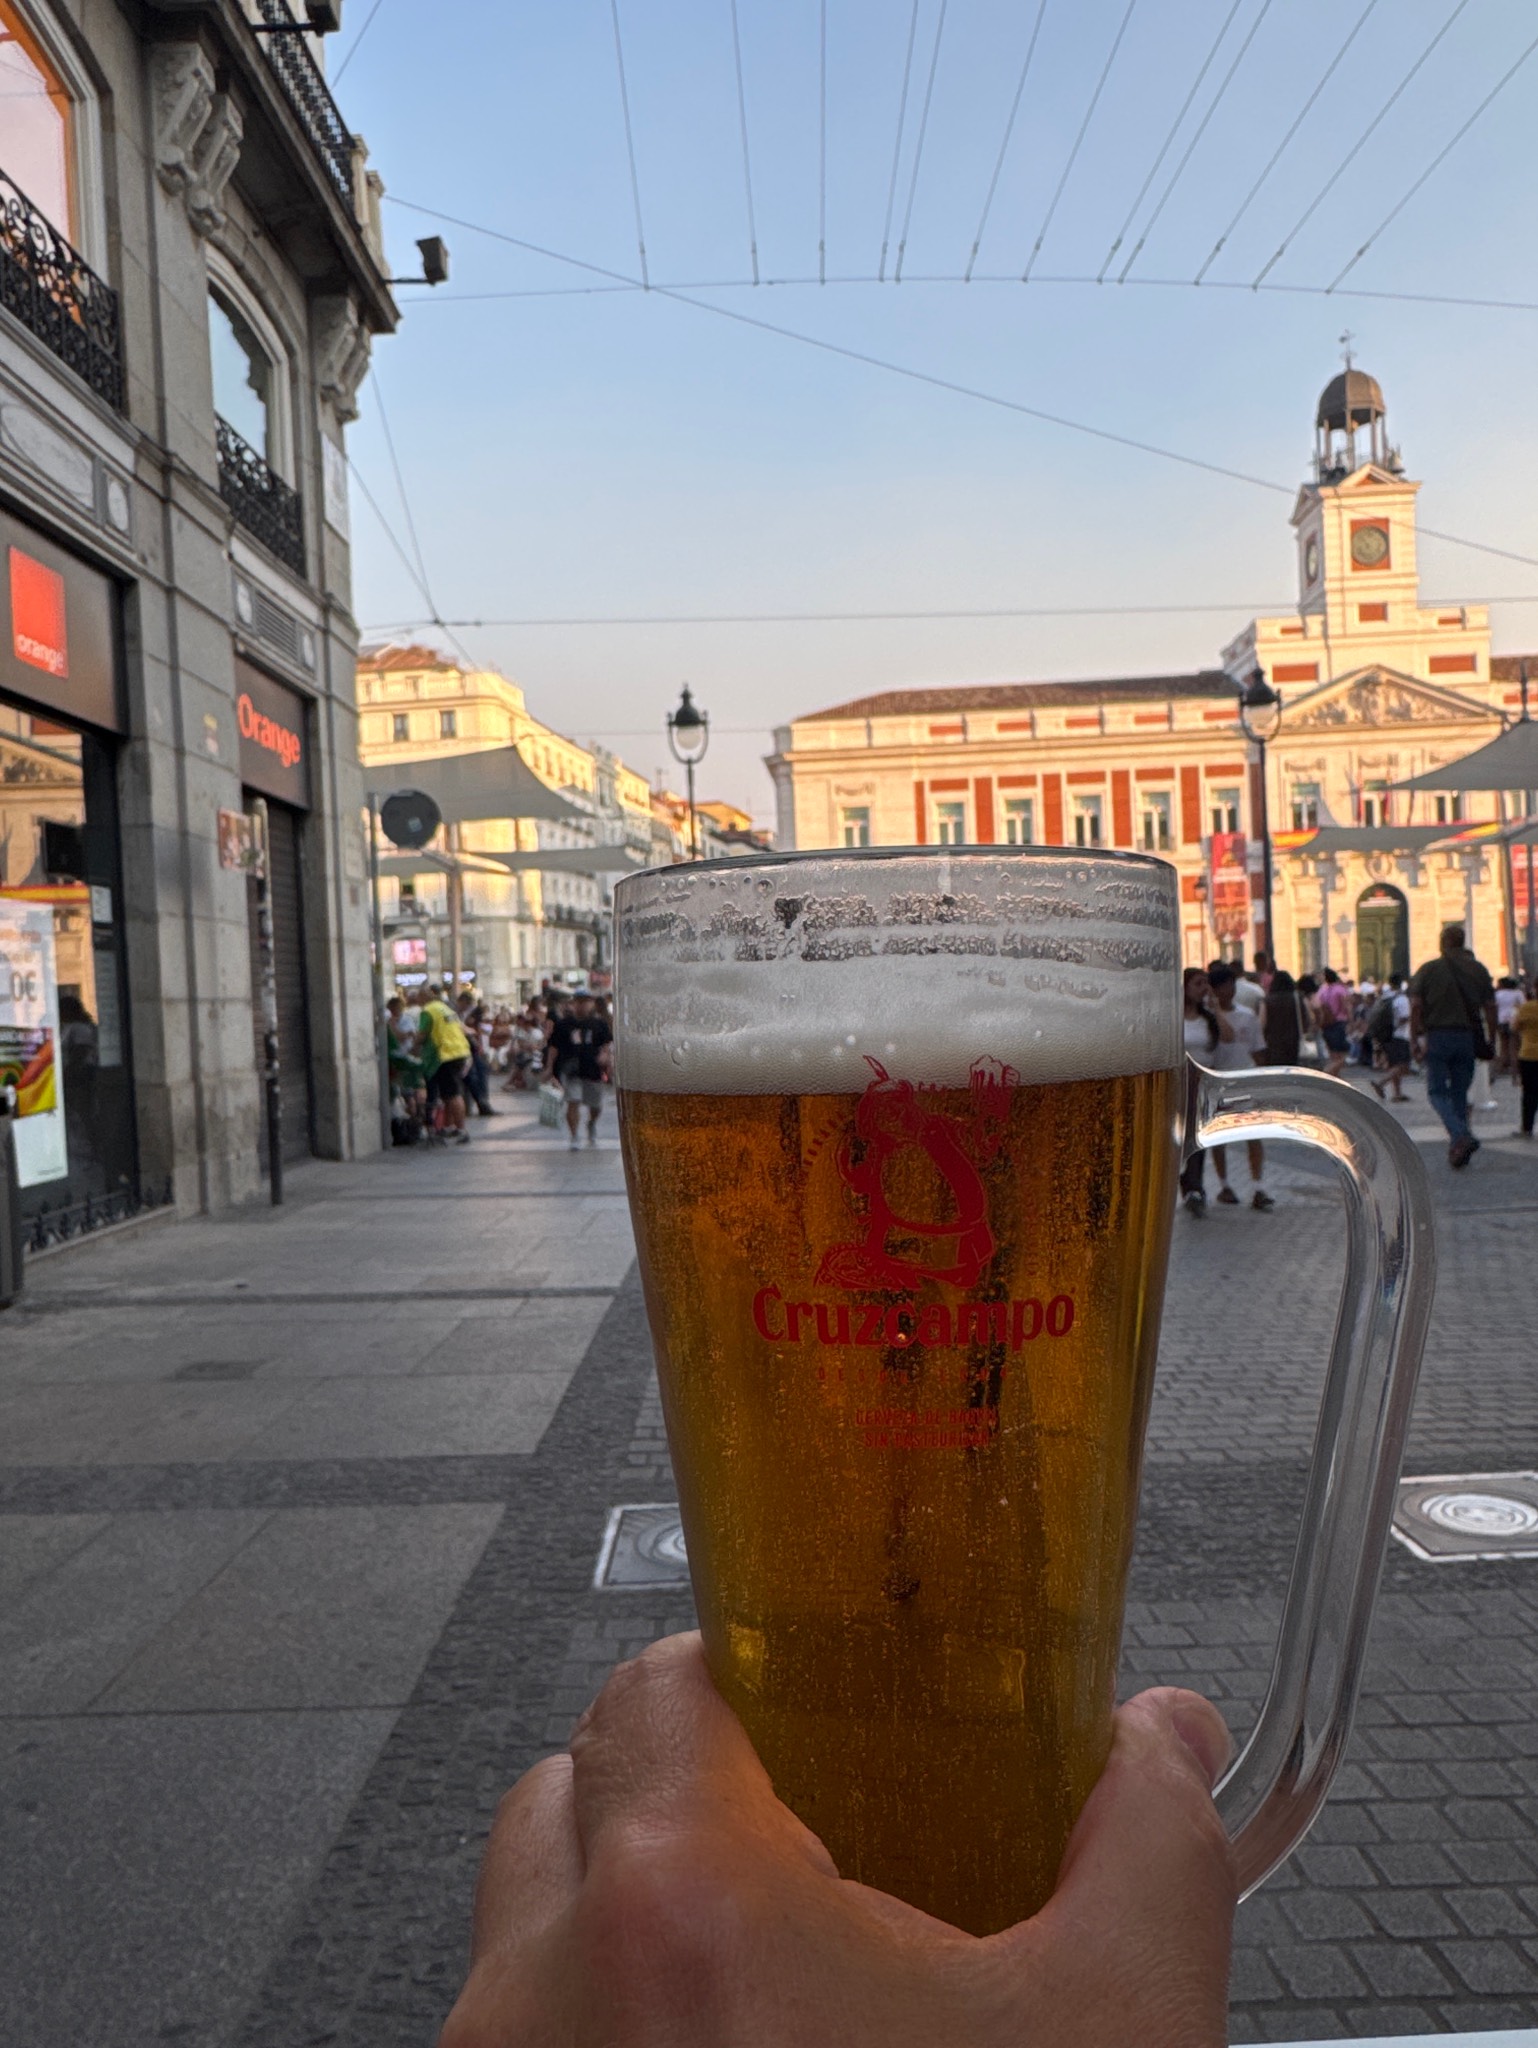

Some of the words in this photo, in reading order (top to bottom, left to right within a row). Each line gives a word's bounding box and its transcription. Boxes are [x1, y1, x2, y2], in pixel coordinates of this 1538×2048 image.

[16, 633, 64, 672] orange
[238, 693, 301, 768] Orange
[752, 1286, 1075, 1355] Cruzcampo
